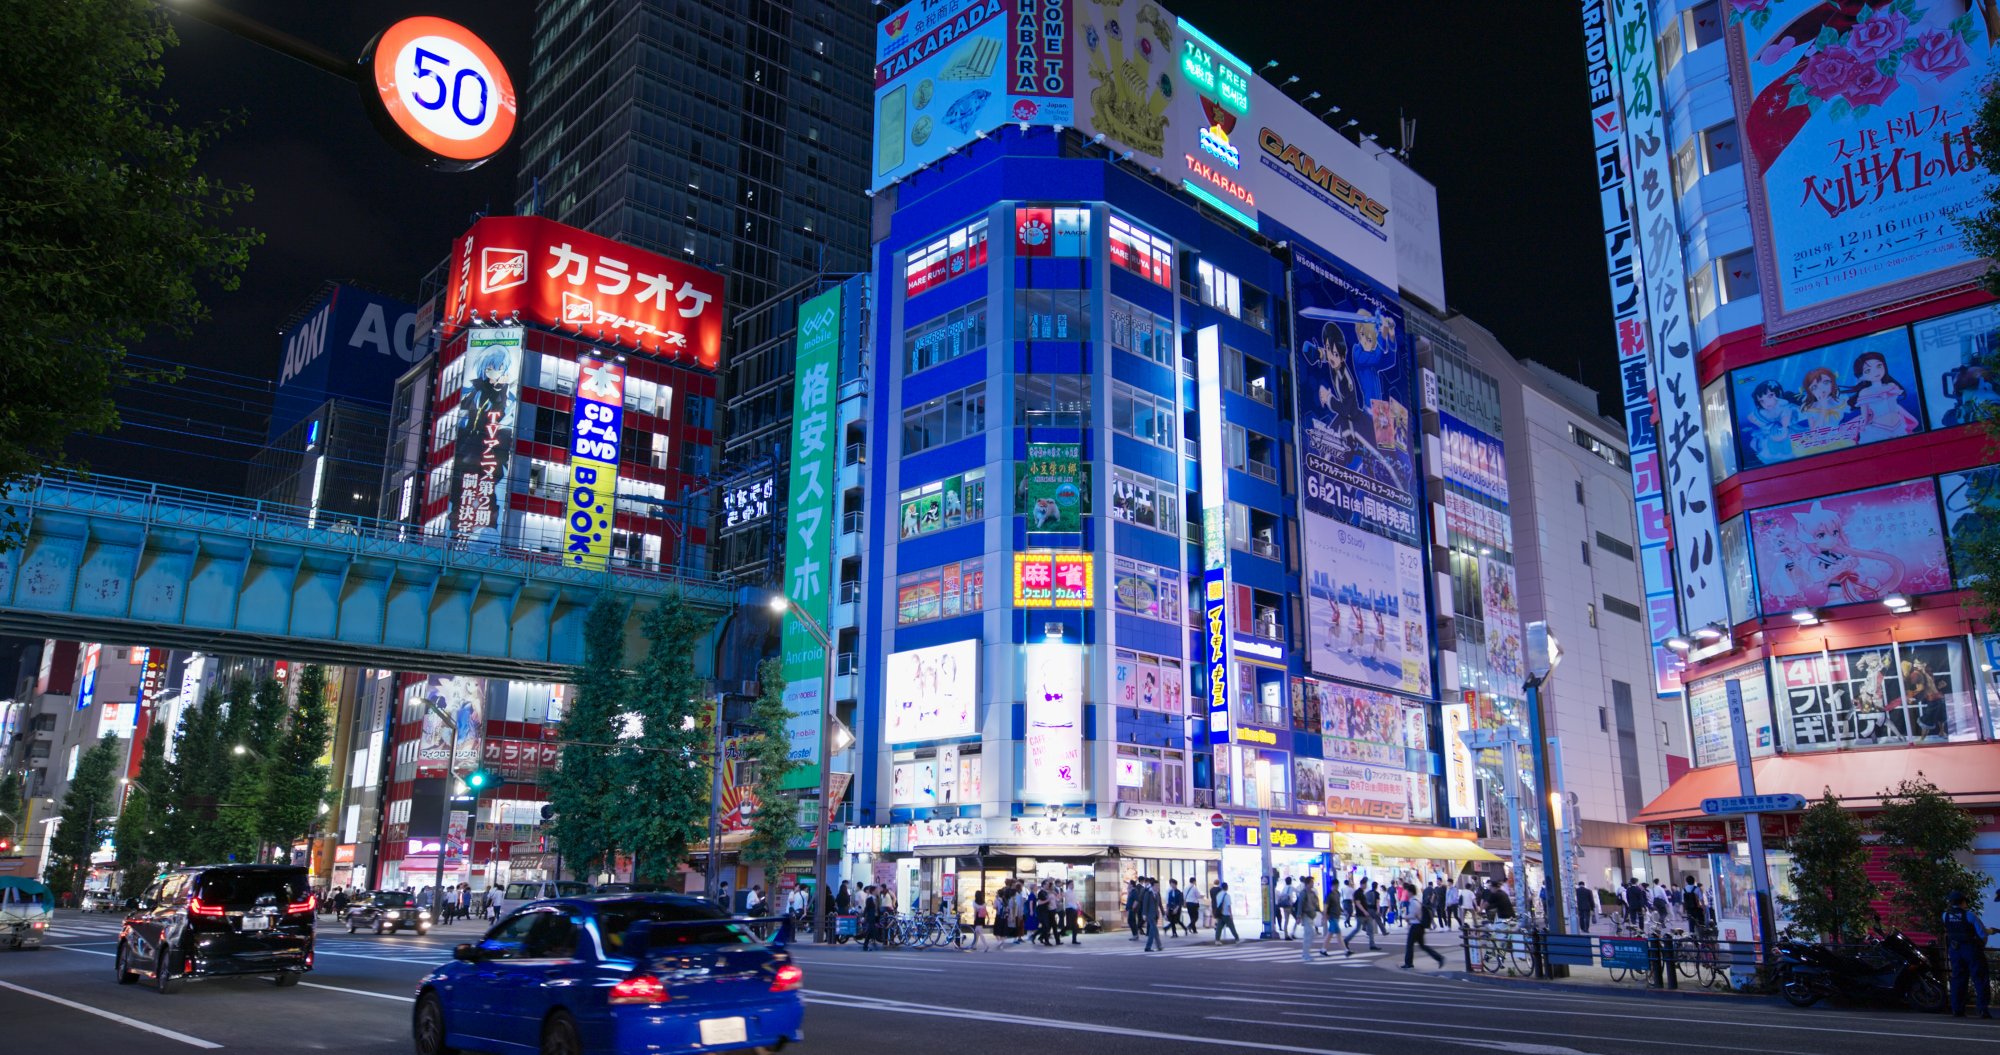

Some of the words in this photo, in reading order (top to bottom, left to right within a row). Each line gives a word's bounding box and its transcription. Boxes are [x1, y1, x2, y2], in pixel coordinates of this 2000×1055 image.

[882, 0, 1002, 80] TAKARADA
[1043, 61, 1062, 91] TO
[1185, 40, 1212, 67] TAX
[1219, 63, 1247, 93] FREE
[411, 47, 489, 126] 50
[1185, 153, 1255, 207] TAKARADA
[1258, 126, 1389, 227] GAMERS
[1111, 246, 1129, 260] HARE
[1131, 254, 1150, 270] RUYA
[456, 235, 475, 325] カラオケ
[546, 242, 713, 319] カラオケ
[908, 275, 927, 289] HARE
[927, 268, 947, 281] RUYA
[595, 309, 687, 348] アドアーズ
[803, 329, 832, 350] mobile
[279, 304, 331, 388] AOKI
[580, 365, 622, 400] 本
[584, 403, 614, 423] CD
[576, 418, 618, 443] ゲーム
[575, 437, 616, 459] DVD
[474, 411, 500, 527] TVアニメ第2期
[791, 361, 831, 601] 格安スマホ
[567, 465, 597, 554] BOOK
[1307, 475, 1416, 535] 6月21日(金)同時発売!
[1021, 563, 1083, 587] 麻雀
[785, 646, 823, 665] Android
[1116, 666, 1127, 681] 2F
[1788, 657, 1843, 689] 4F
[1125, 684, 1136, 701] 3F
[421, 750, 478, 759] マイクロマジン社
[485, 743, 556, 763] カラオケ
[1327, 795, 1407, 820] GAMERS
